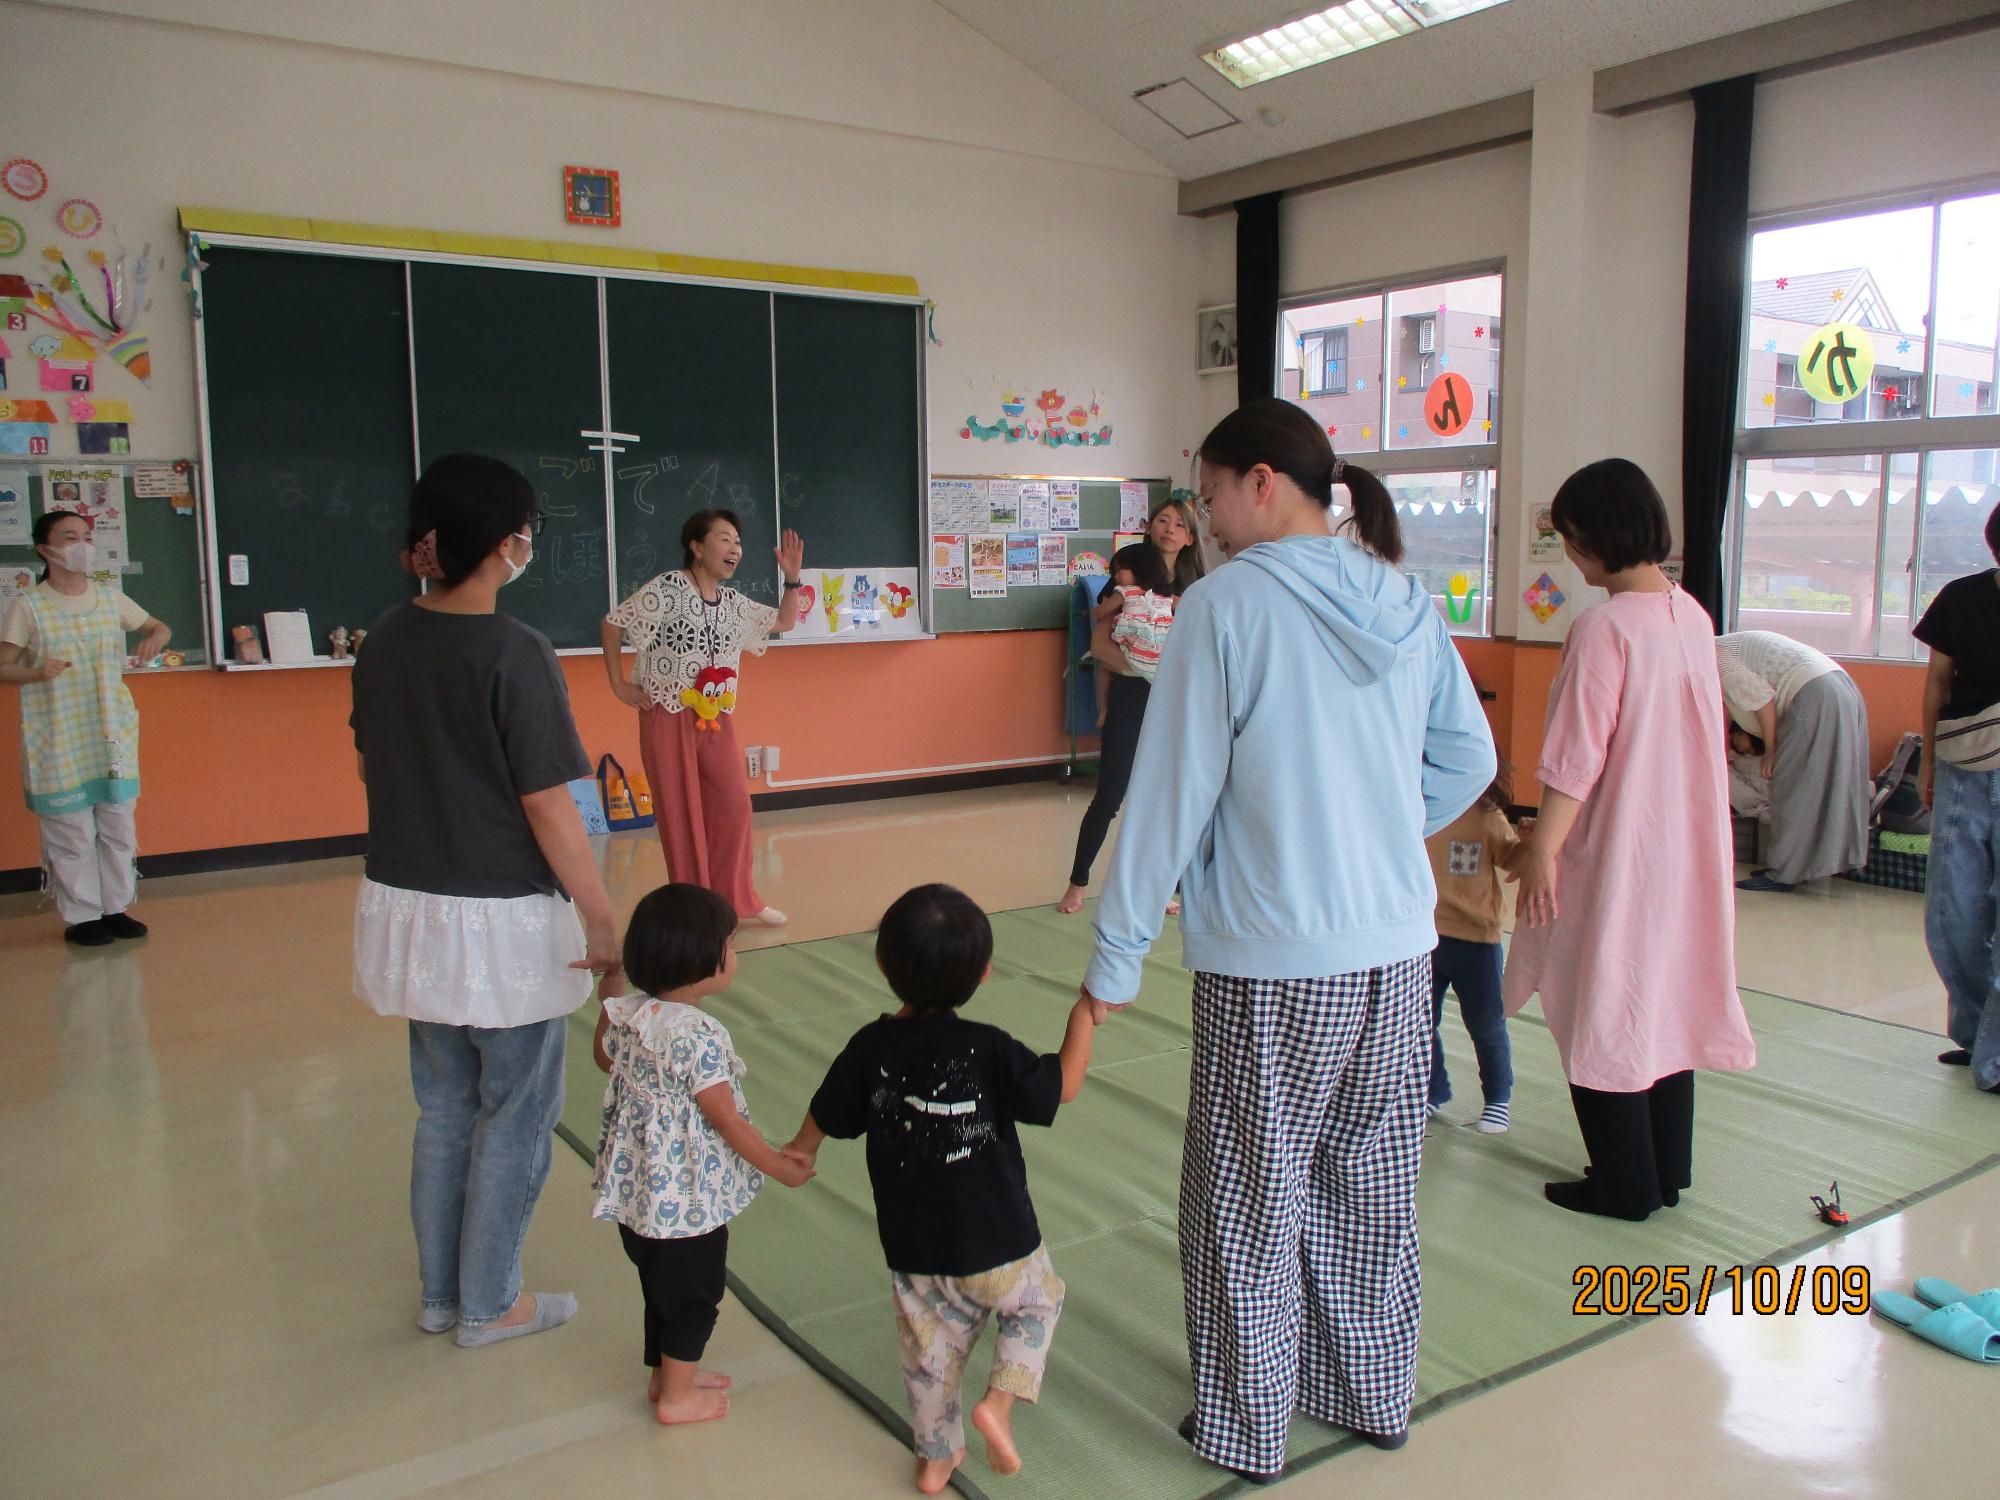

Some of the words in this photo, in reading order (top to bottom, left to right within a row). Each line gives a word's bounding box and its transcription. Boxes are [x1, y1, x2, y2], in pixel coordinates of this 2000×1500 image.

[12, 314, 24, 329] 3
[74, 376, 87, 390] 7
[32, 439, 48, 453] 11
